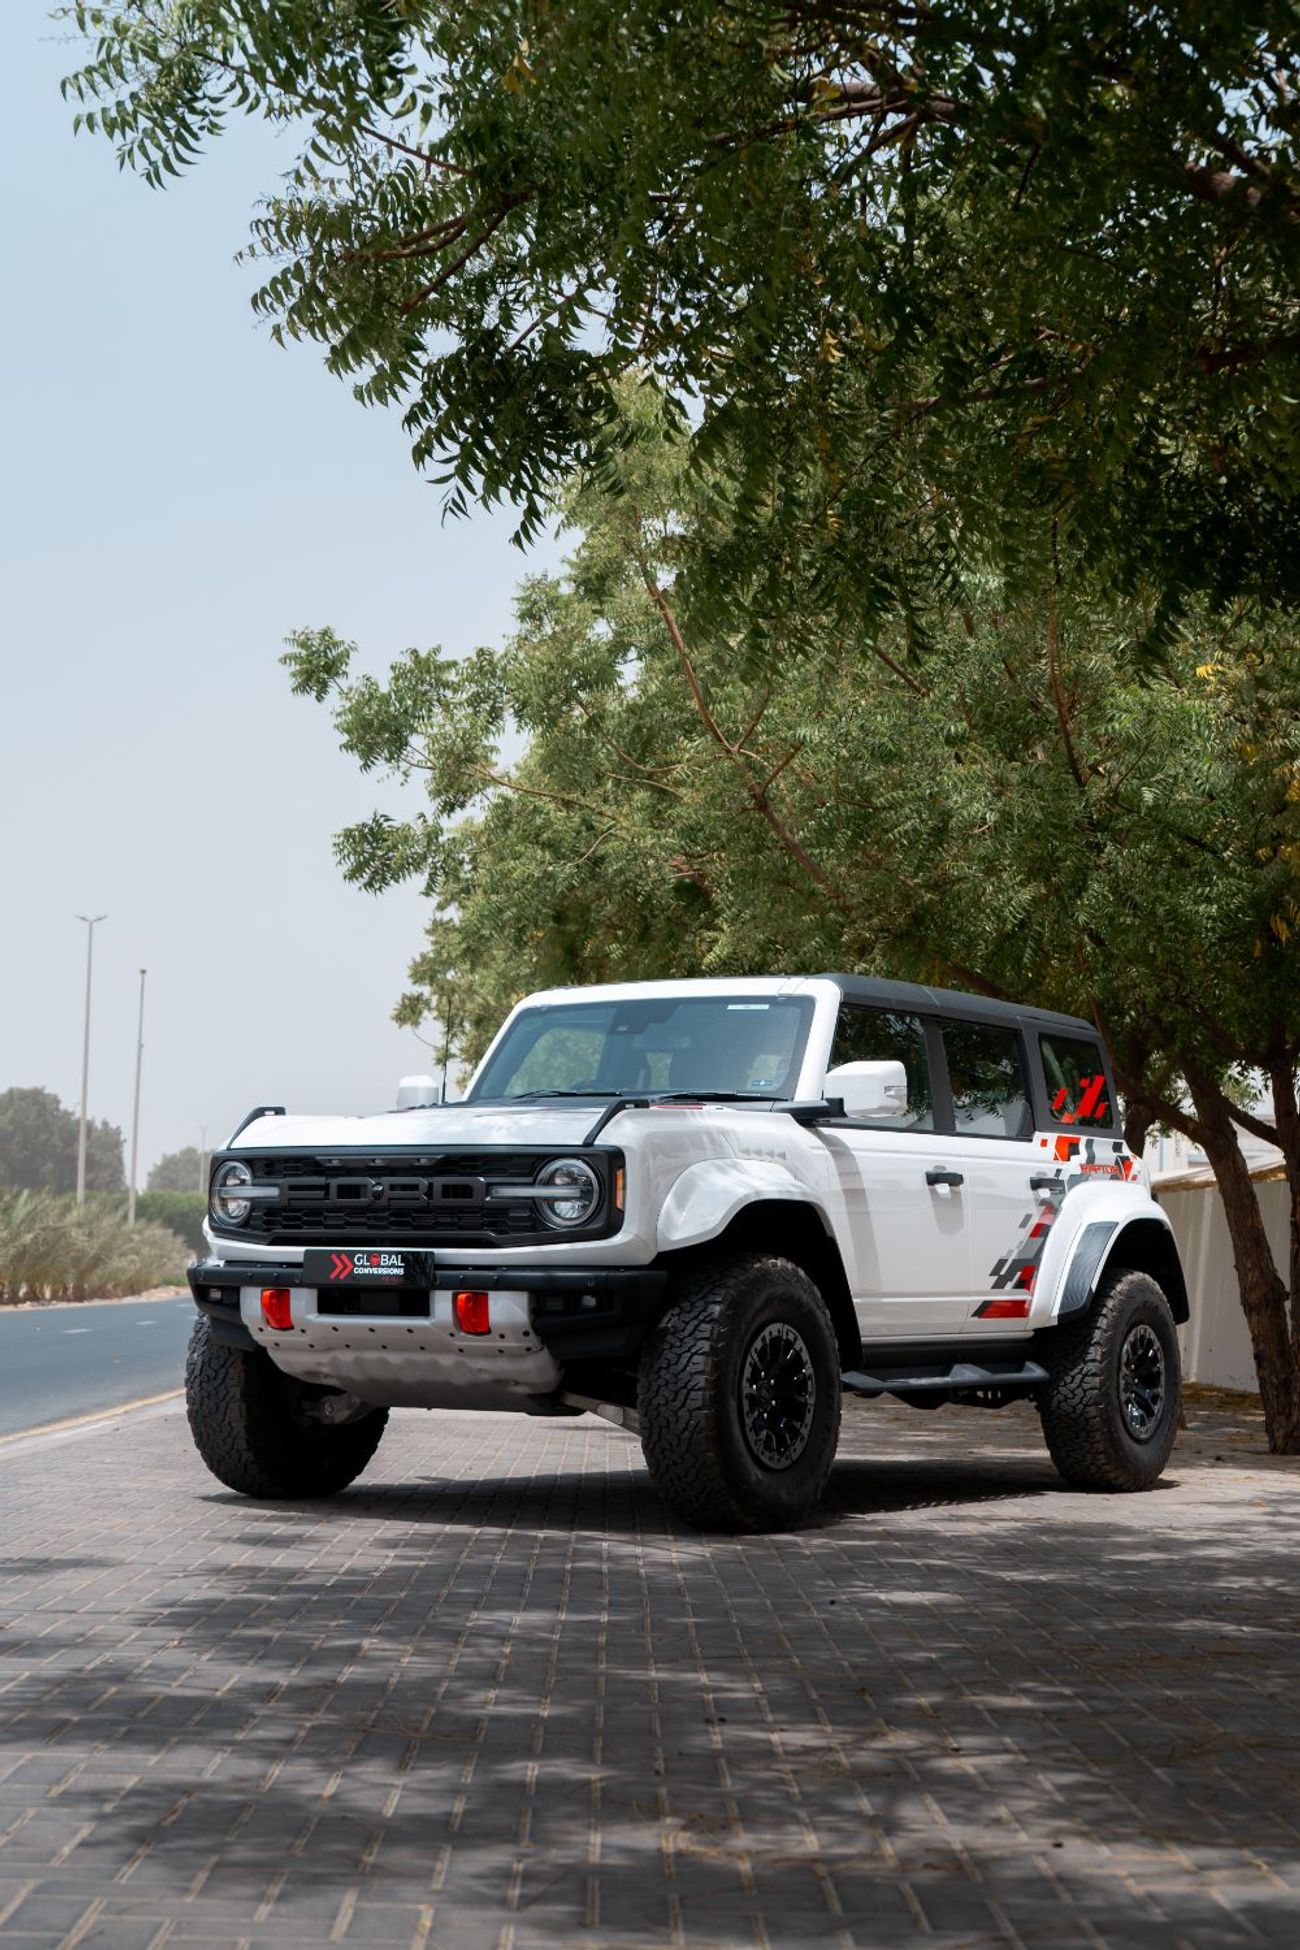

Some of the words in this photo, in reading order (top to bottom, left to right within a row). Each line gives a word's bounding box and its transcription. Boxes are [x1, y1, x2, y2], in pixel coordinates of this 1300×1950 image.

[279, 1177, 486, 1207] FORD
[354, 1253, 405, 1266] GLOBAL
[353, 1267, 405, 1275] CONVERSIONS
